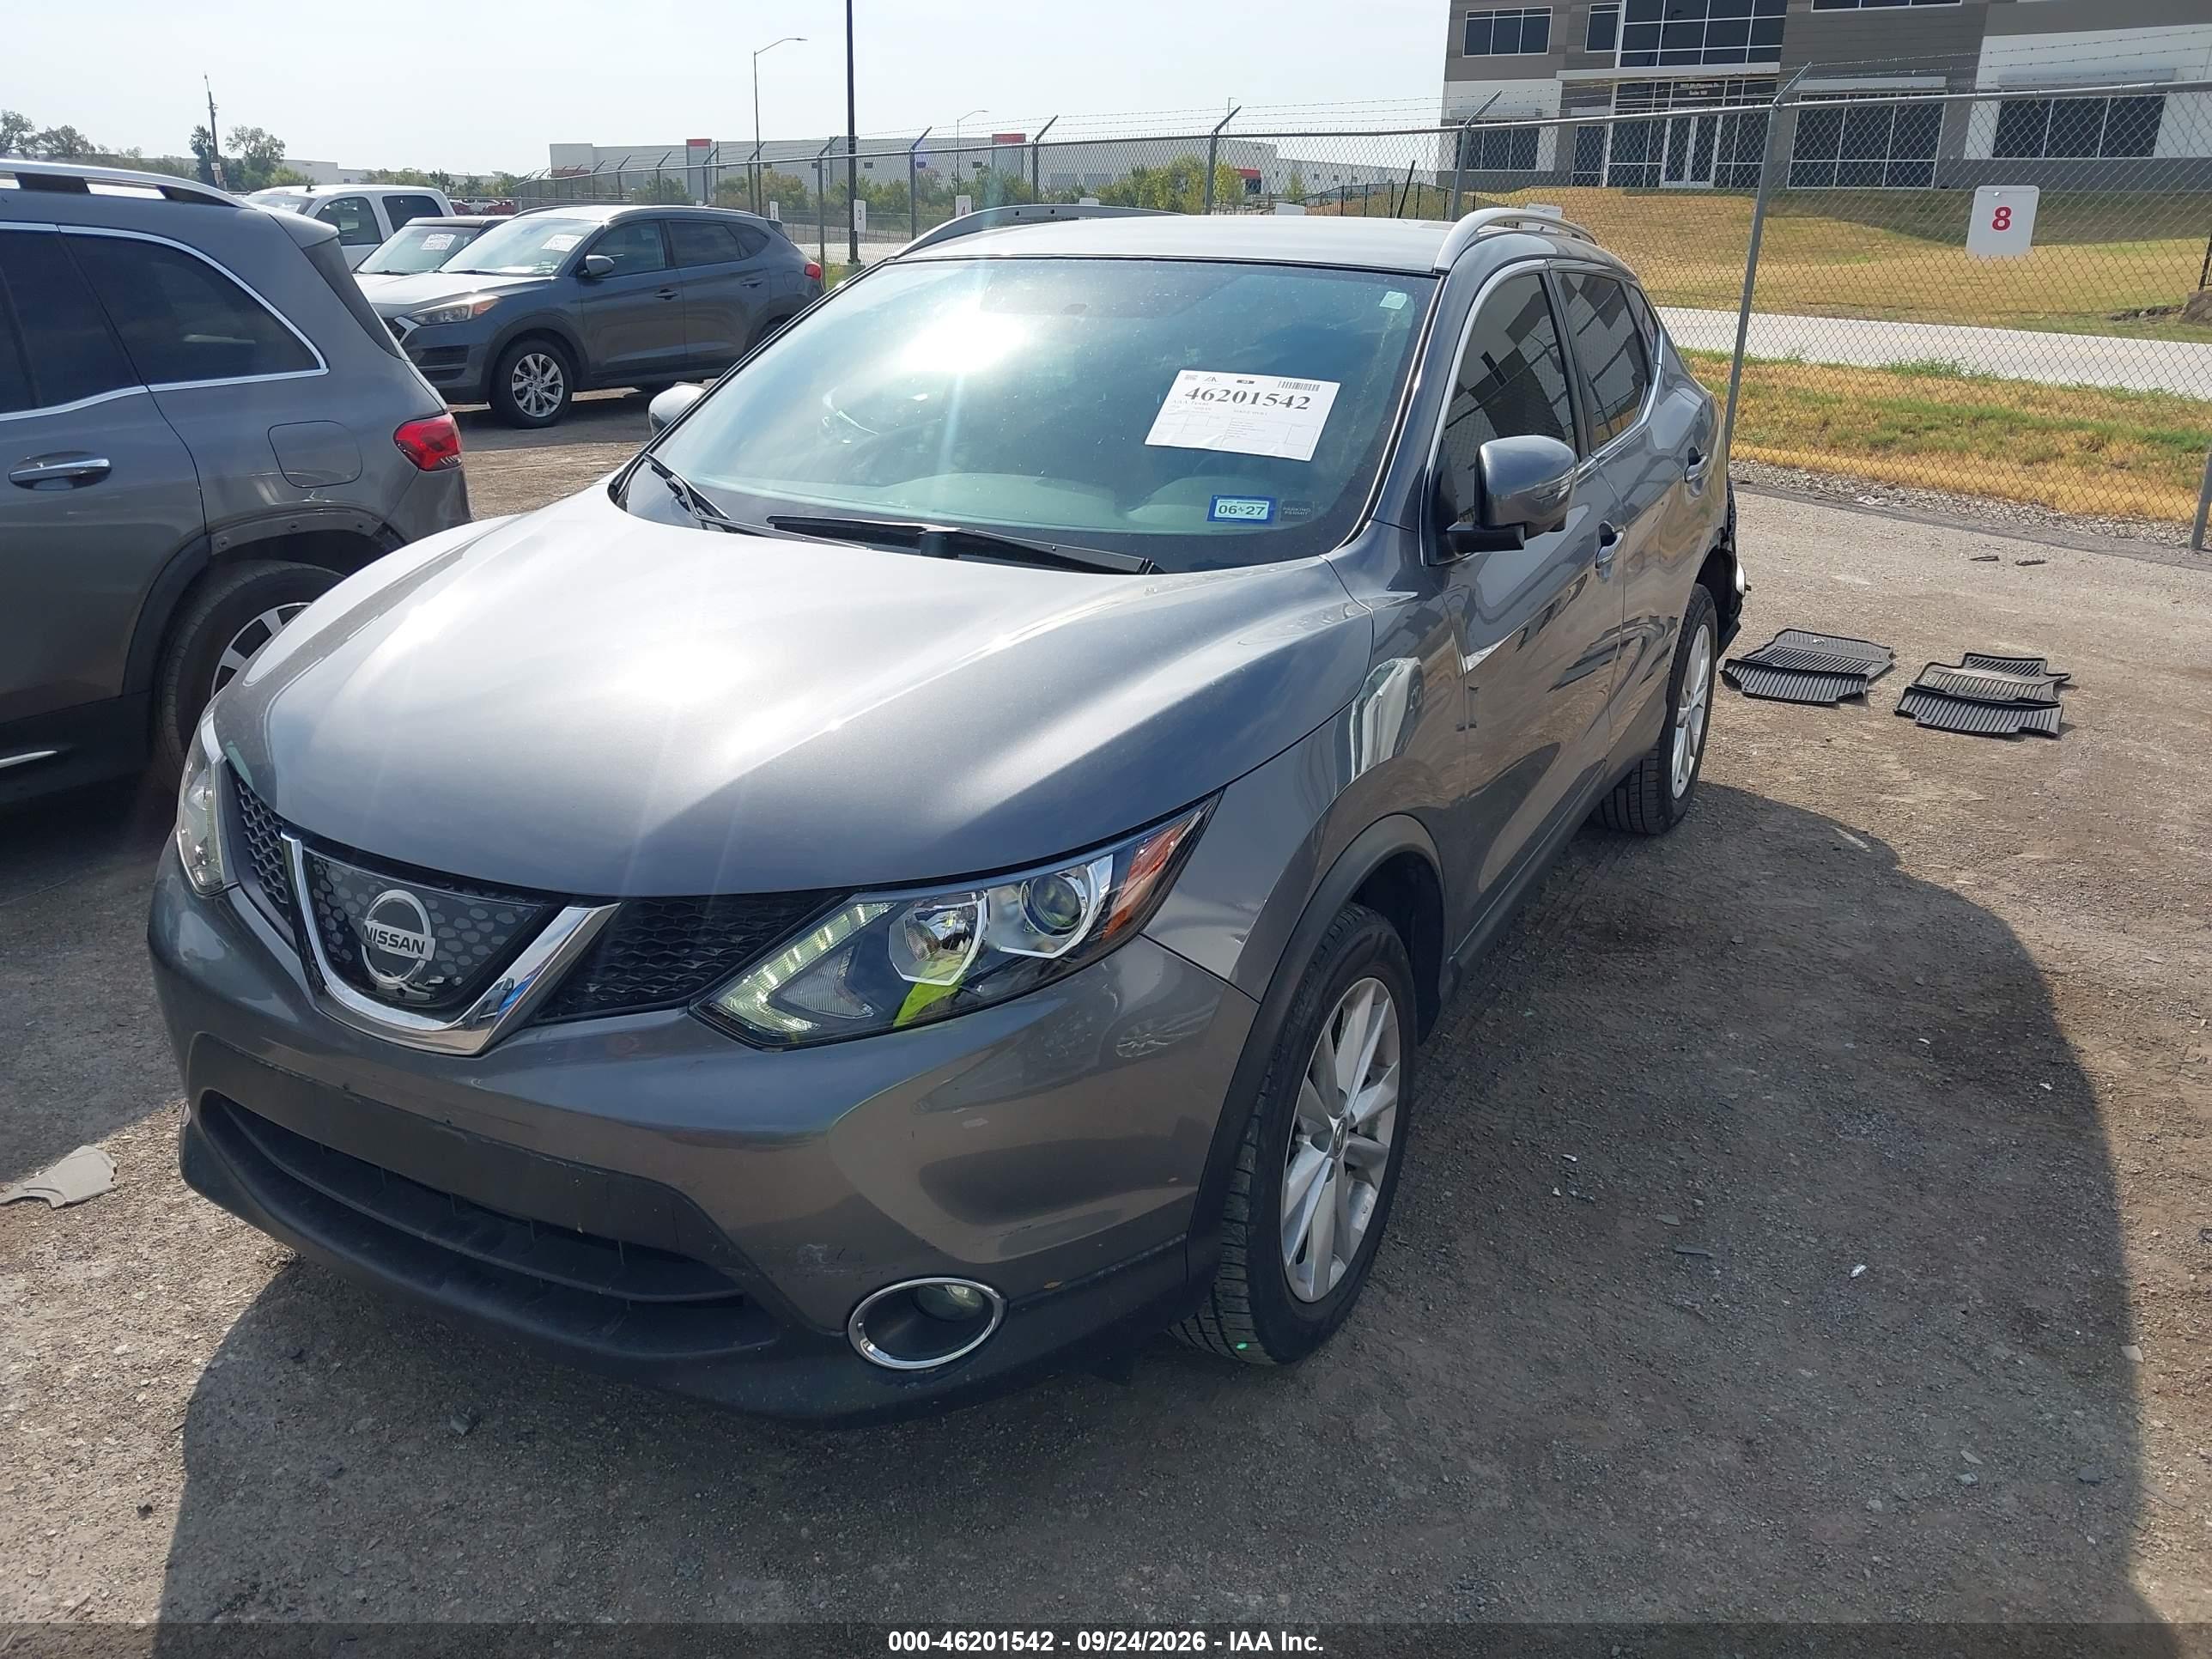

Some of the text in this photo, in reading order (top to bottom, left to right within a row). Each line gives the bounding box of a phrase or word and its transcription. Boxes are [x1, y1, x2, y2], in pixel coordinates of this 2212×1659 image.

[858, 209, 862, 221] 3
[1991, 206, 2012, 231] 8
[1184, 386, 1311, 410] 46201542
[1218, 504, 1266, 516] 06 27
[362, 924, 426, 955] NISSAN
